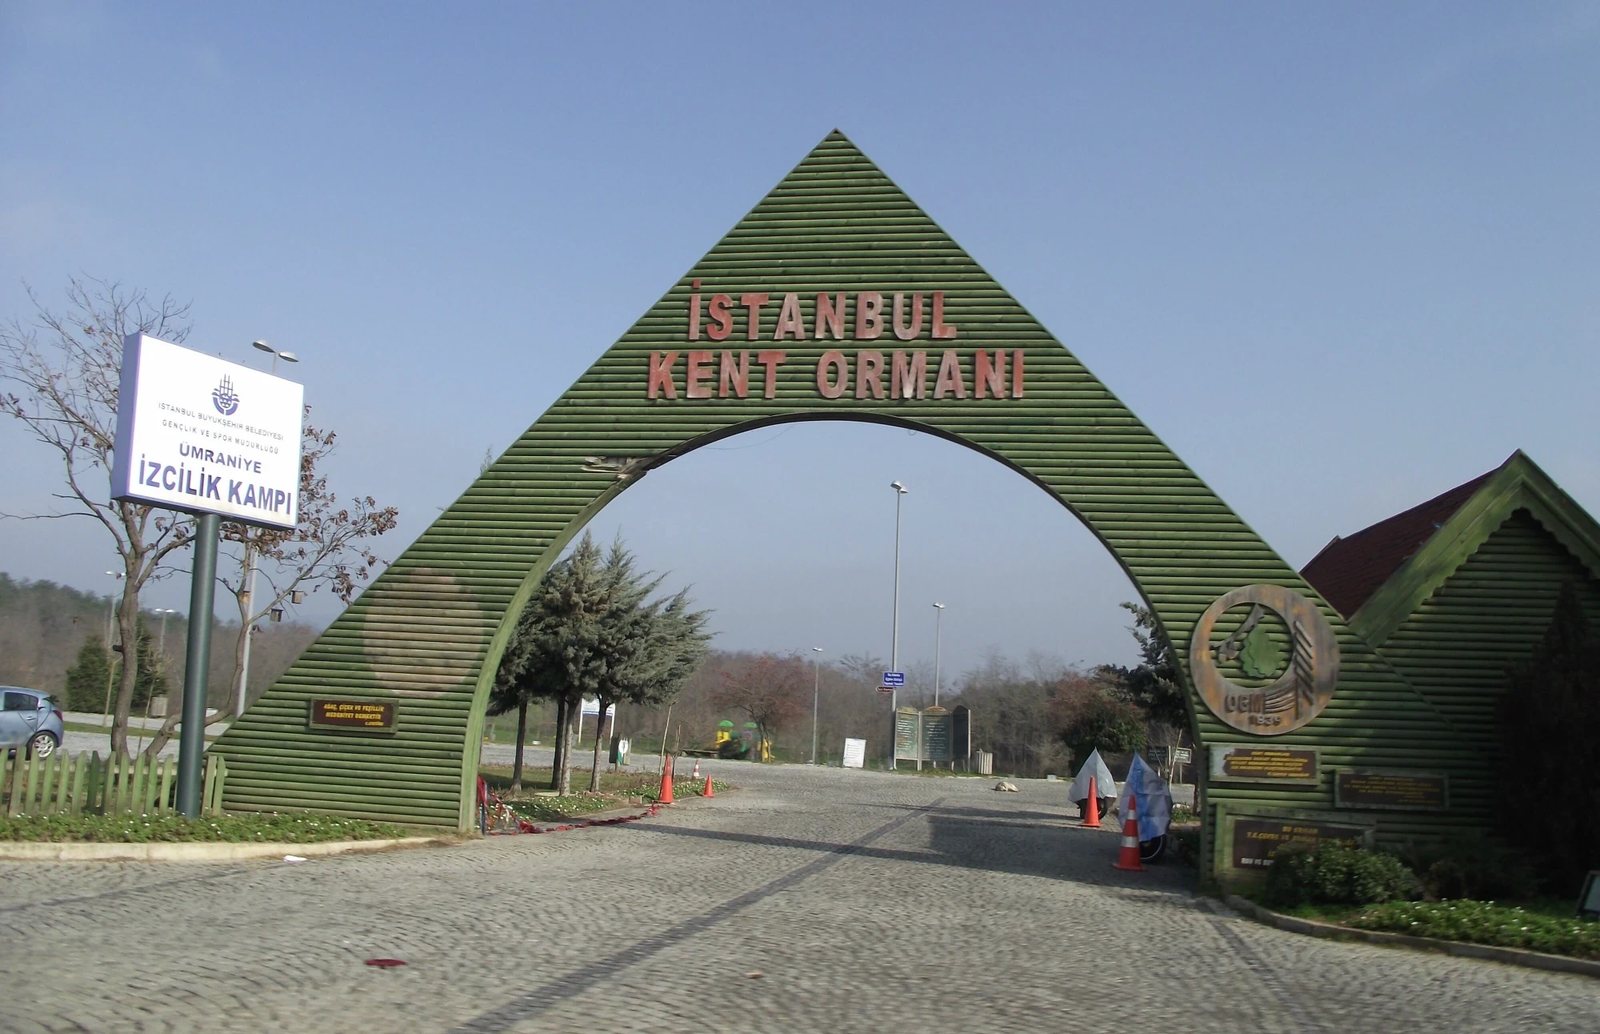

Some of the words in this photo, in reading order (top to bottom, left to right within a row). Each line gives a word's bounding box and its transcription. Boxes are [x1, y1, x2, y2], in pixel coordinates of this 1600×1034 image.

[689, 280, 957, 340] İSTANBUL
[648, 350, 787, 399] KENT
[816, 349, 1024, 399] ORMANI
[179, 440, 262, 474] ÜMRANİYE
[200, 429, 210, 438] VE
[139, 453, 222, 501] İZCİLİK
[228, 479, 292, 515] KAMPI
